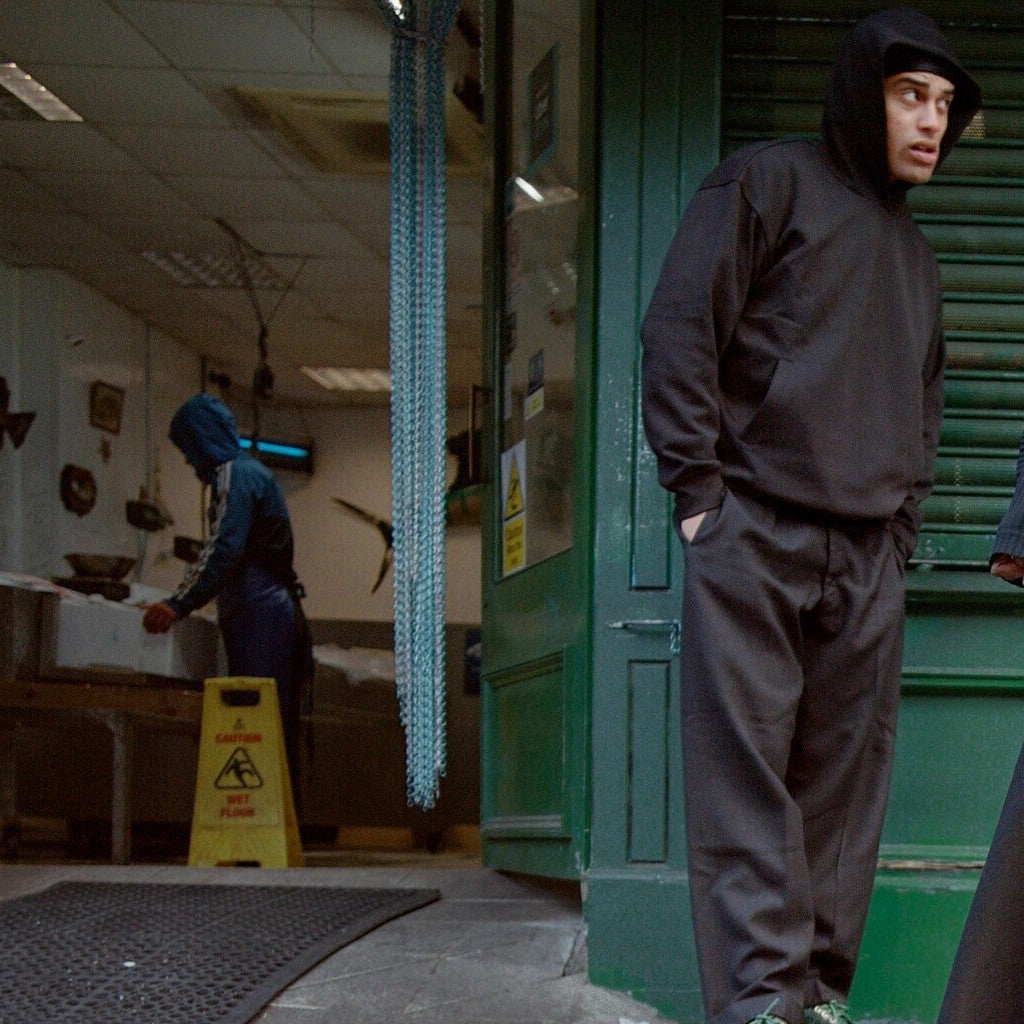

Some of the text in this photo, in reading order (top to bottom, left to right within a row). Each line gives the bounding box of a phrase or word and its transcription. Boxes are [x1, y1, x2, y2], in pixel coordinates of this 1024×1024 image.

[215, 732, 262, 744] CAUTION
[227, 795, 250, 804] WET
[221, 807, 255, 817] FLOOR
